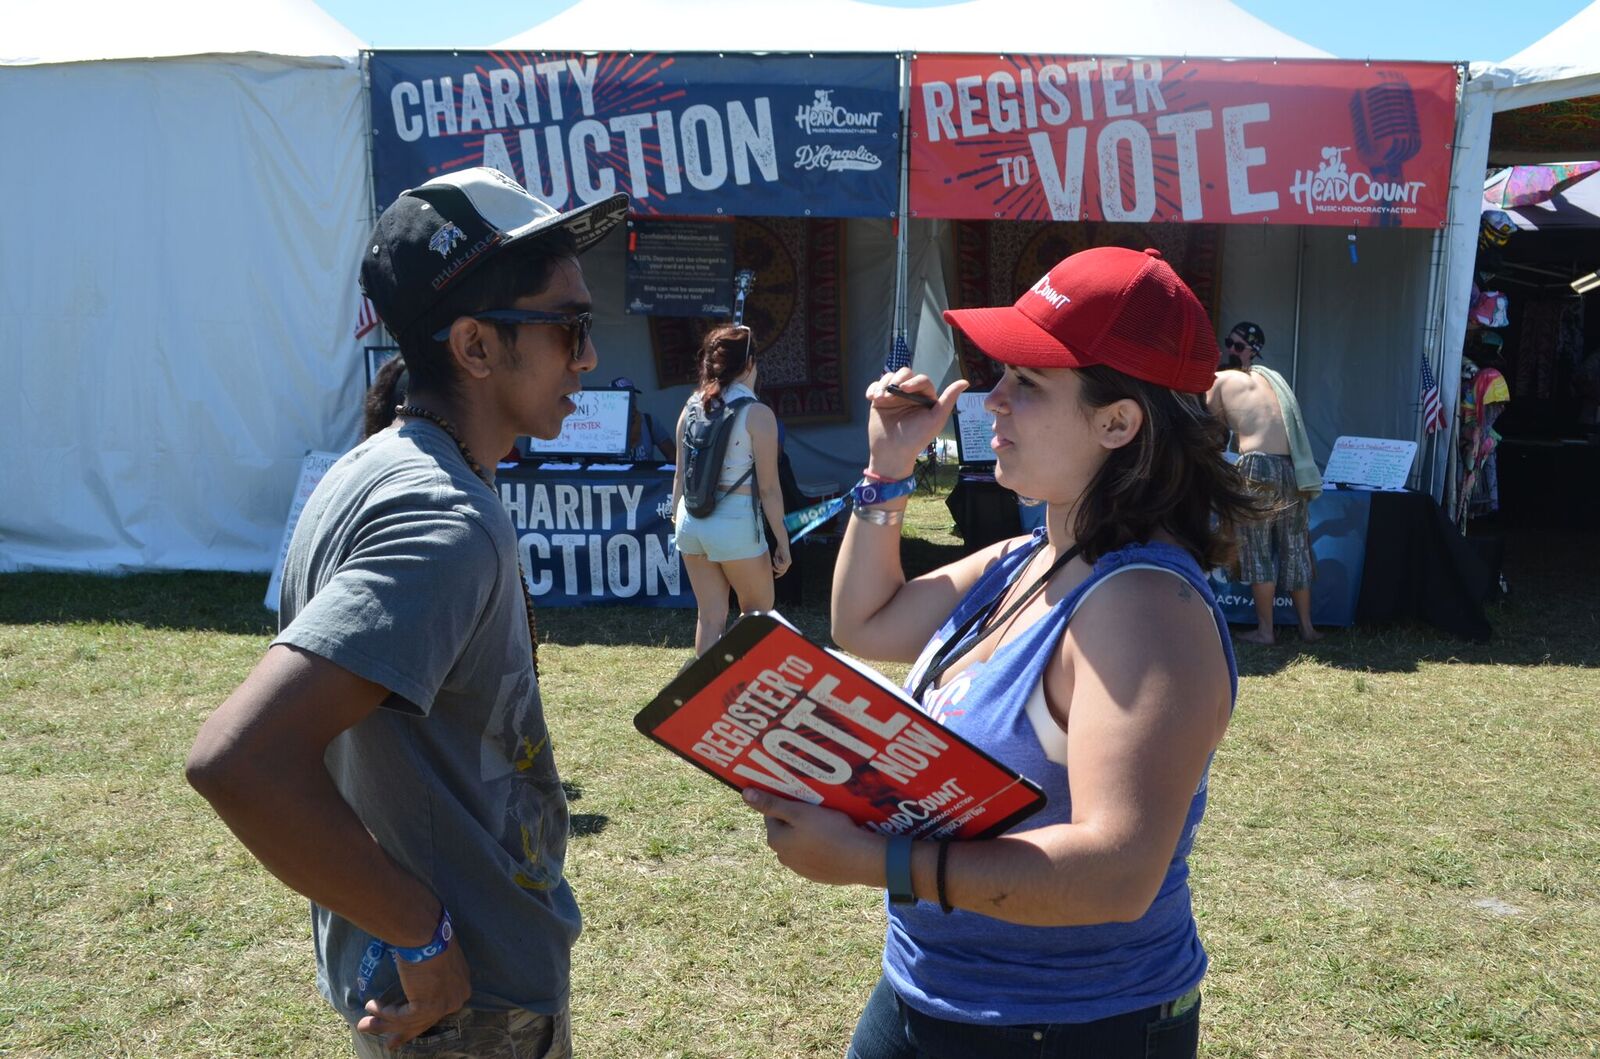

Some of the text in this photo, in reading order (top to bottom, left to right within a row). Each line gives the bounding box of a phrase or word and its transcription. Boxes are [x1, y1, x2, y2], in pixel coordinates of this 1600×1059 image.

[391, 58, 598, 141] CHARITY
[922, 59, 1167, 142] REGISTER
[483, 97, 778, 210] AUCTION
[794, 145, 881, 170] D'Angelico
[997, 102, 1279, 223] TO VOTE
[501, 483, 644, 530] HARITY
[518, 533, 681, 598] CTION
[692, 655, 813, 768] REGISTER TO
[733, 673, 911, 805] VOTE
[869, 721, 949, 785] NOW
